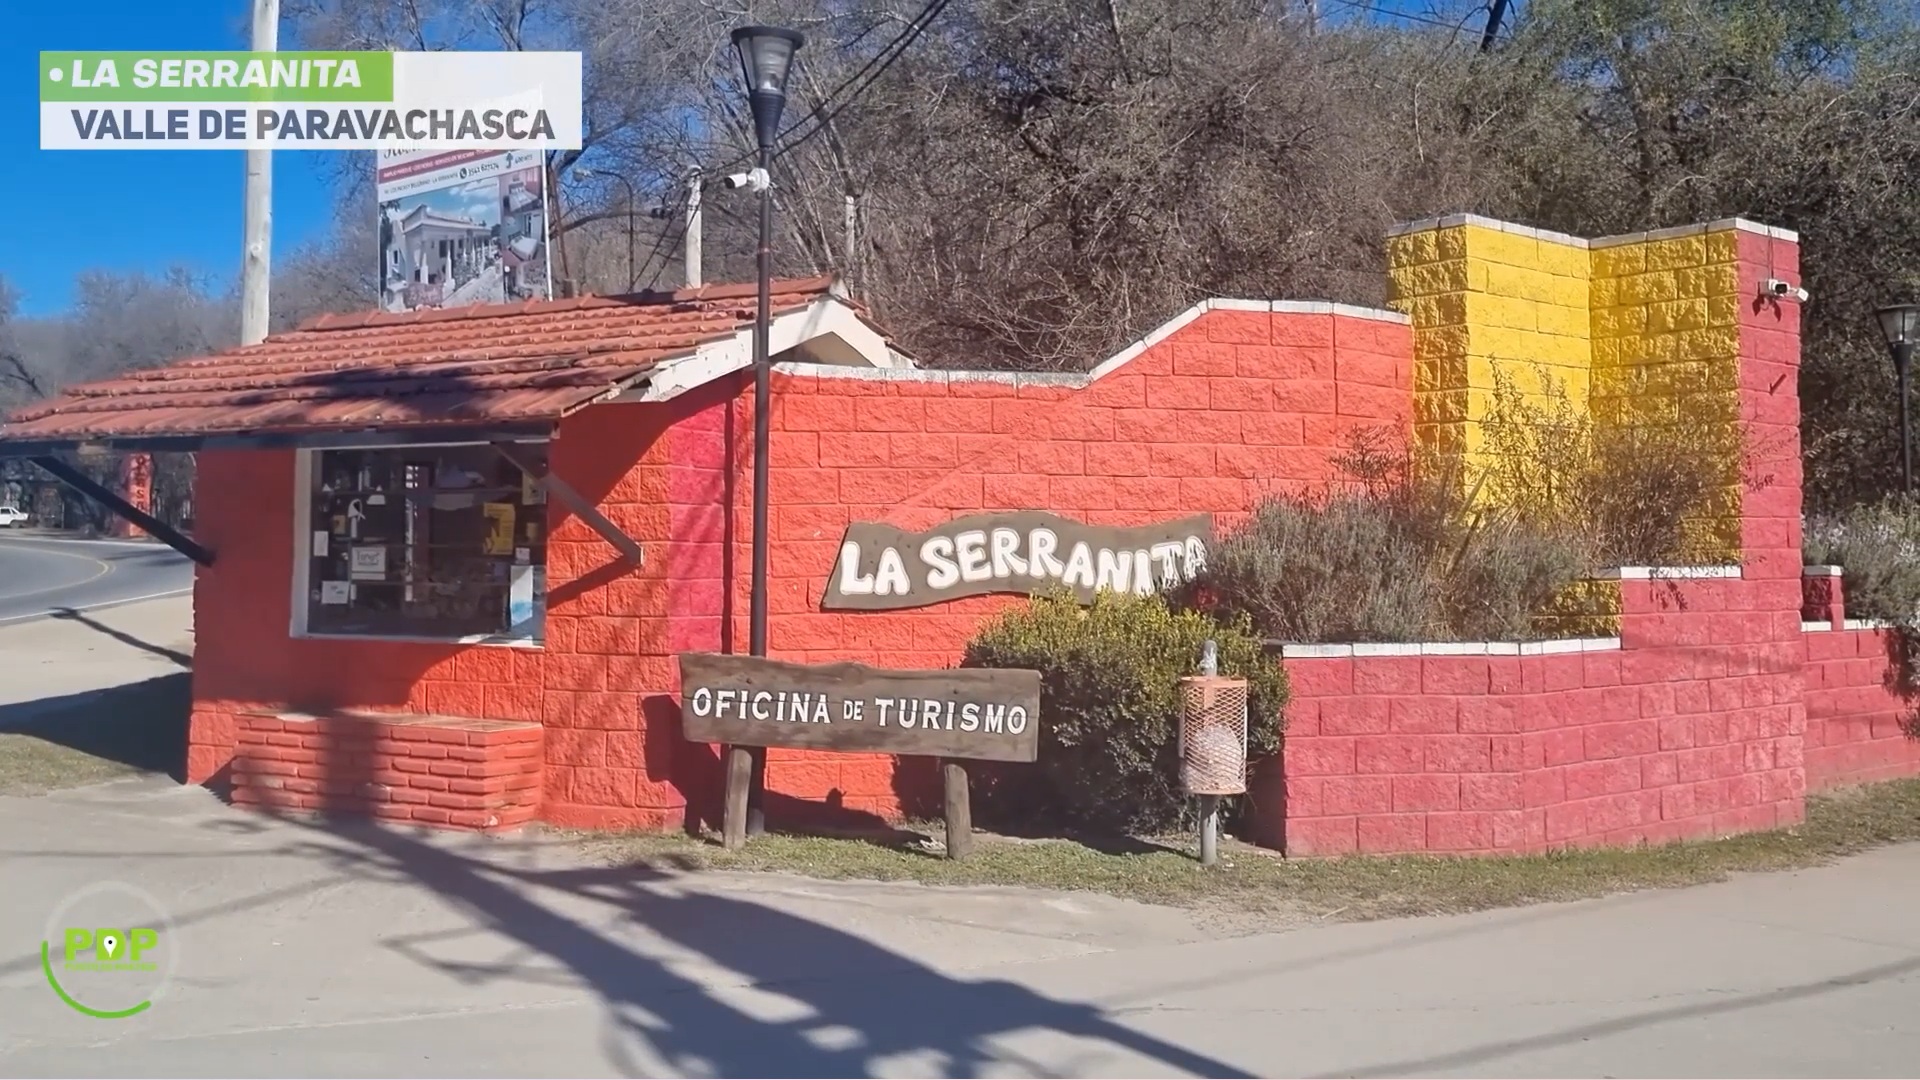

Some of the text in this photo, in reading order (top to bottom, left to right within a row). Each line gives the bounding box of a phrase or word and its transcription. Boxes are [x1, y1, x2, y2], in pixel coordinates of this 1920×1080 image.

[839, 527, 1207, 596] LA SERRANITA
[692, 687, 1028, 735] OFICINA DE TURISMO
